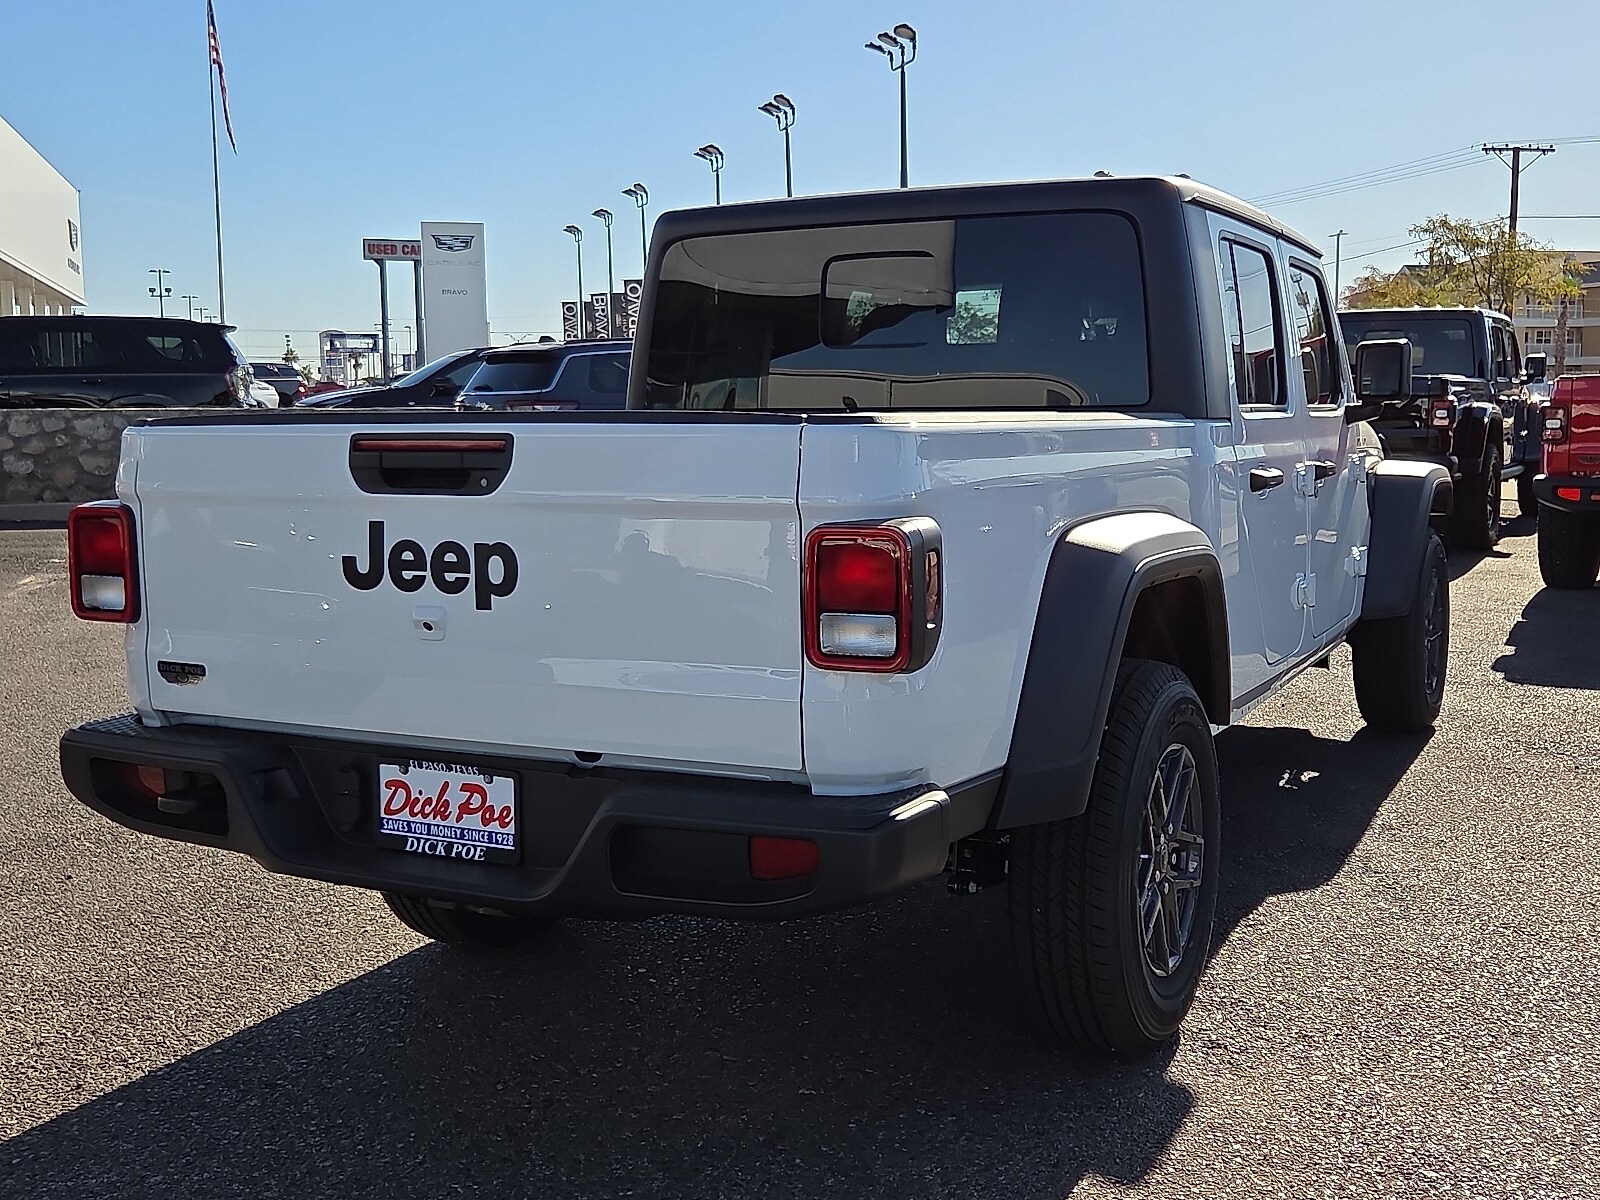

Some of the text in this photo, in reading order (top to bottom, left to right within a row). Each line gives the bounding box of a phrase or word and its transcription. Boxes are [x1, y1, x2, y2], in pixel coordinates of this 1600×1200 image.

[368, 243, 421, 256] USED CA
[563, 303, 577, 340] RAVO
[341, 520, 519, 610] Jeep
[159, 663, 204, 675] DICK POE
[409, 759, 419, 769] EL
[450, 764, 479, 776] TEXAS
[383, 779, 515, 829] Dick Poe
[383, 818, 514, 846] SAVES YOU MONEY SINCE 1928
[404, 837, 487, 861] DICK POE
